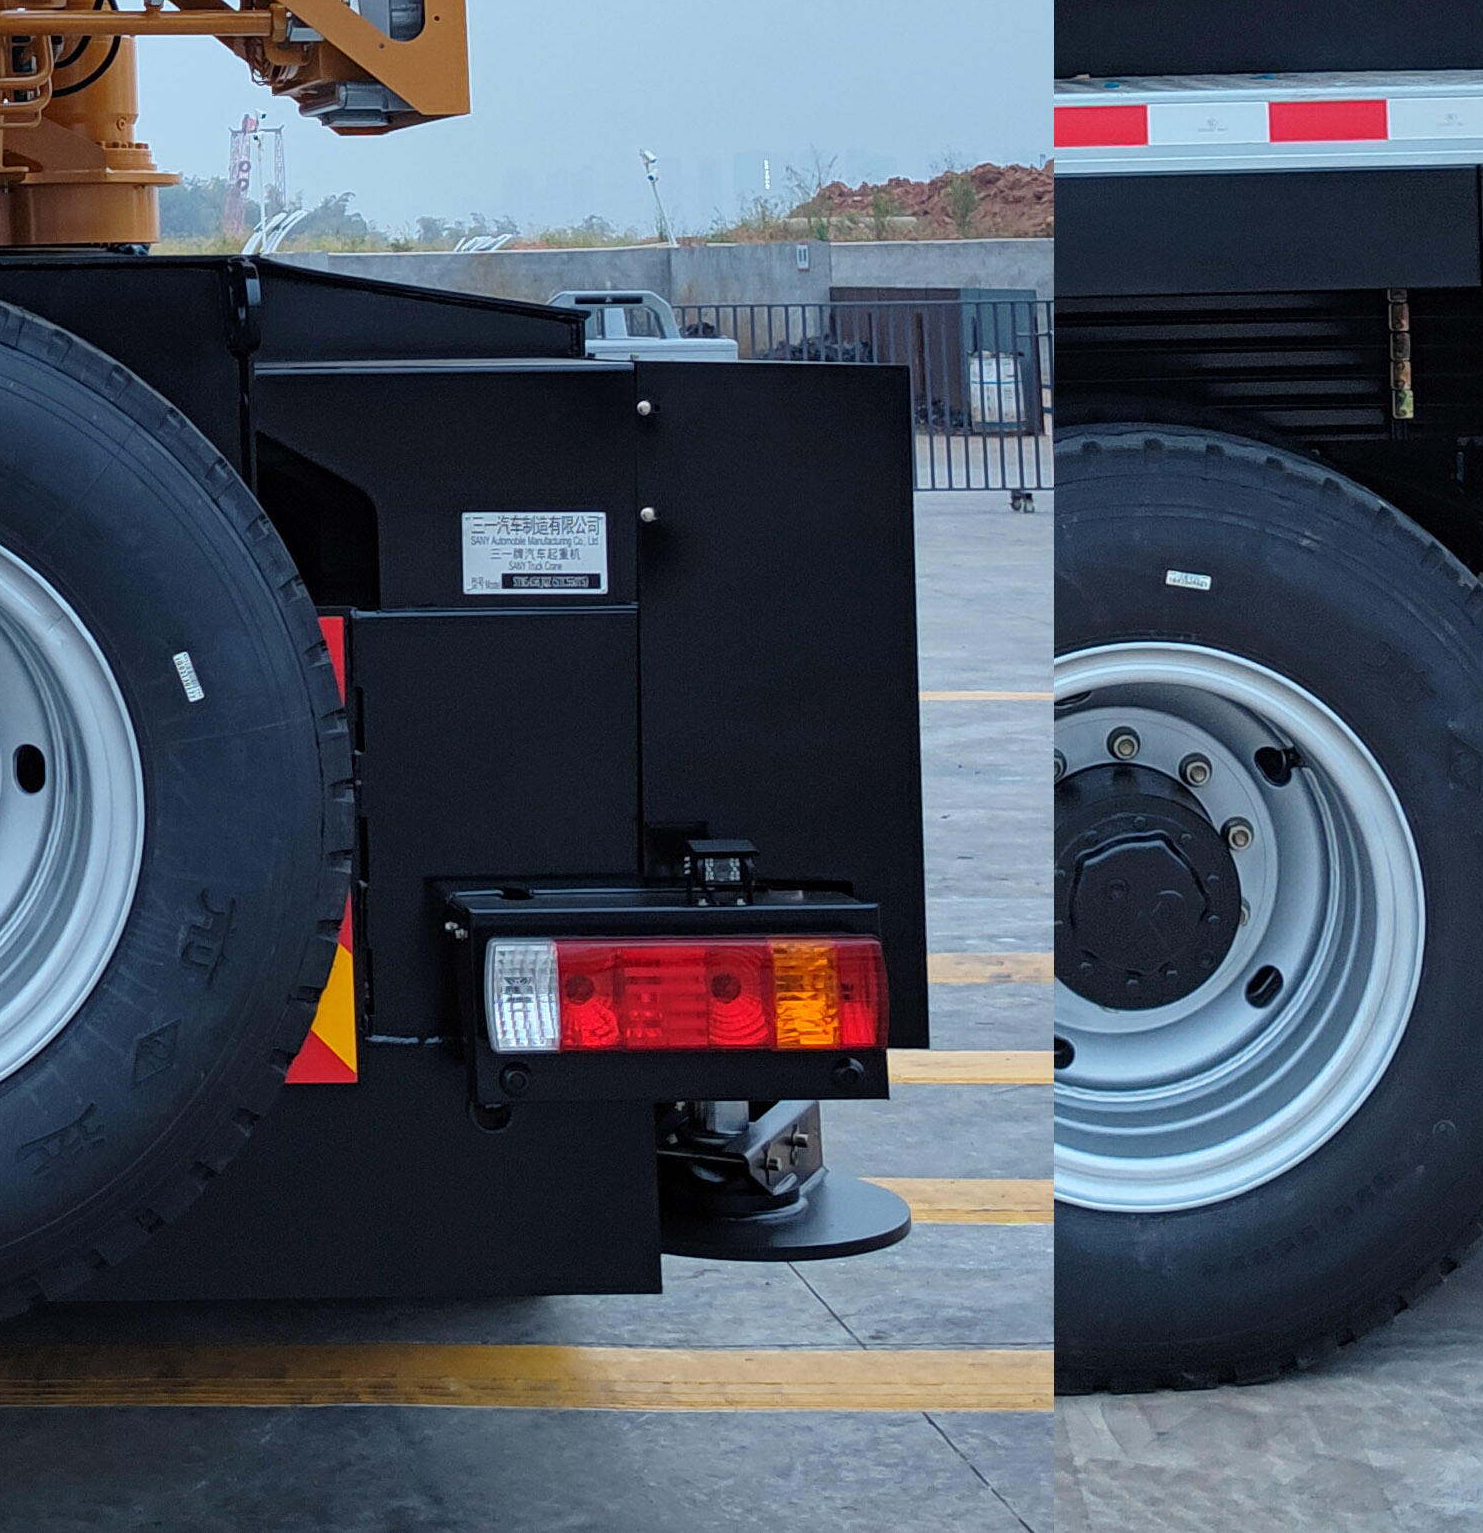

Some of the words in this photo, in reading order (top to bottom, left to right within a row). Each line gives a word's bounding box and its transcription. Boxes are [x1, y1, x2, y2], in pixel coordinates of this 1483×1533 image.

[471, 515, 601, 535] 三一汽车制造有限公司
[471, 536, 489, 545] SANY
[491, 536, 525, 545] Automobile
[527, 536, 572, 548] Manufacturing
[491, 548, 580, 560] 三一牌汽车起重机
